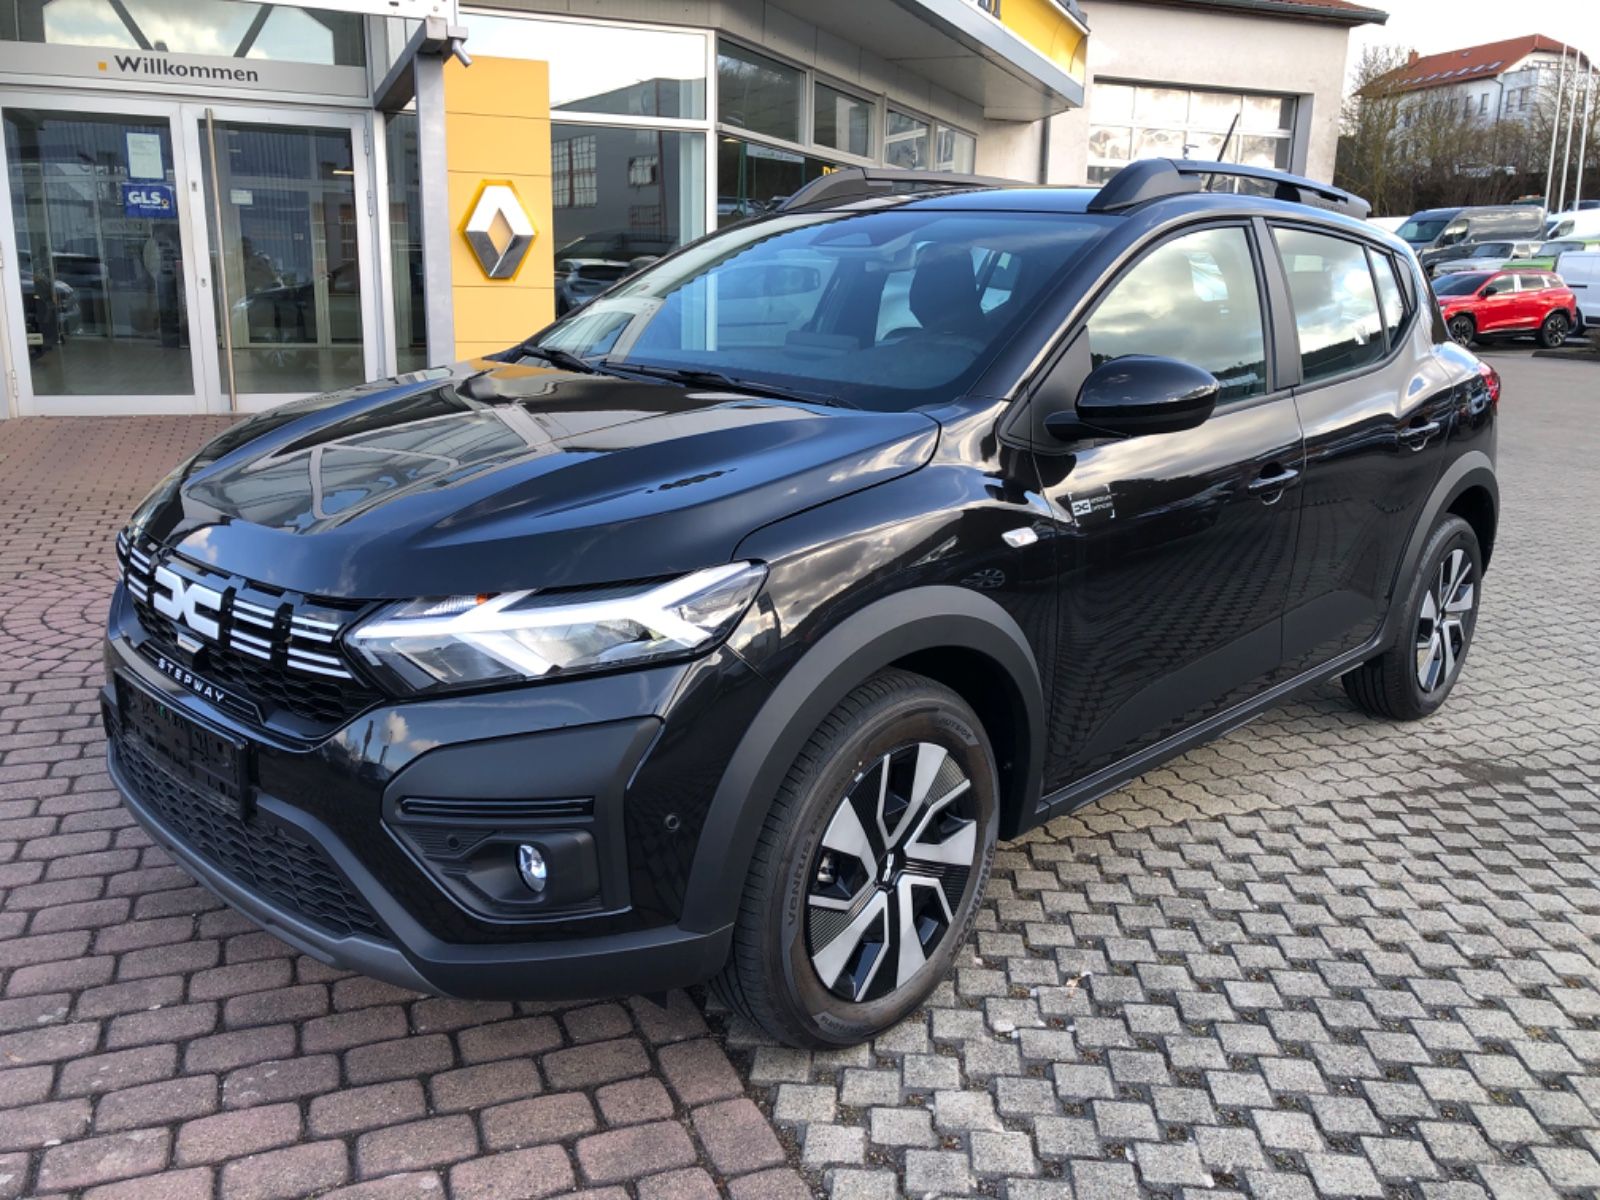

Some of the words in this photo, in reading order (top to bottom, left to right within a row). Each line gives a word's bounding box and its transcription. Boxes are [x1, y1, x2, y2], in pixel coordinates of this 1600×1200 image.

[114, 55, 259, 82] Willkommen
[128, 191, 161, 205] GLS
[158, 658, 224, 702] STEPWAY
